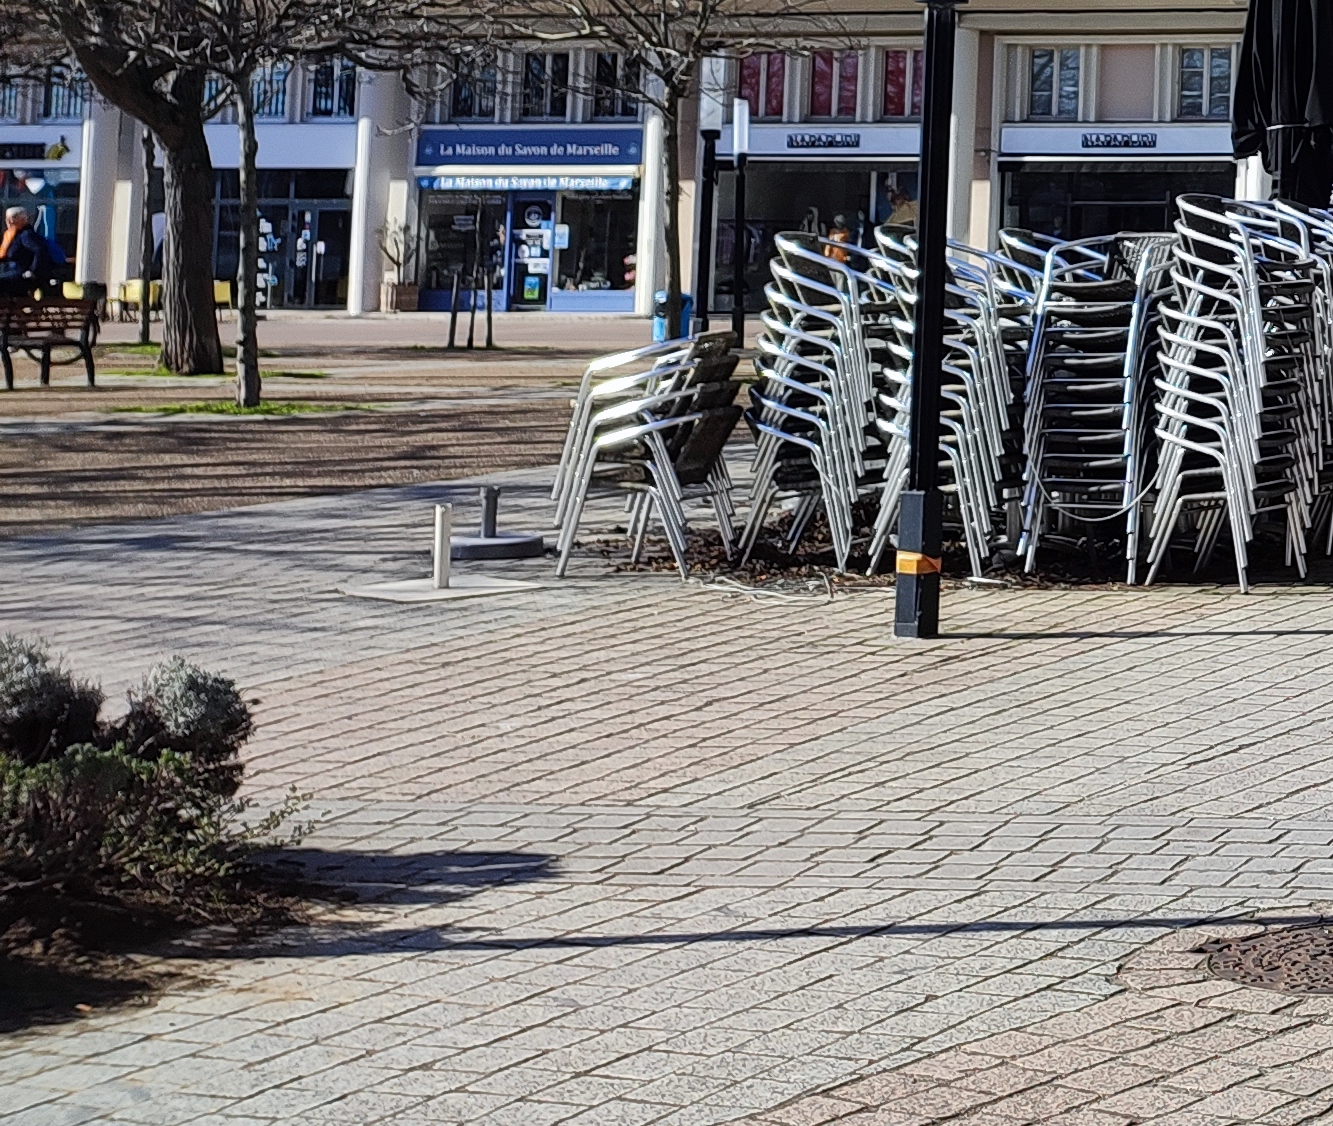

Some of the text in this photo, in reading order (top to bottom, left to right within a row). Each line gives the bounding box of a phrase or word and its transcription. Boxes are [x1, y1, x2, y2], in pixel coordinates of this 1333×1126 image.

[439, 142, 620, 156] La Maison du Savon de Marseille
[455, 177, 493, 188] Maison
[559, 177, 608, 188] Marseille
